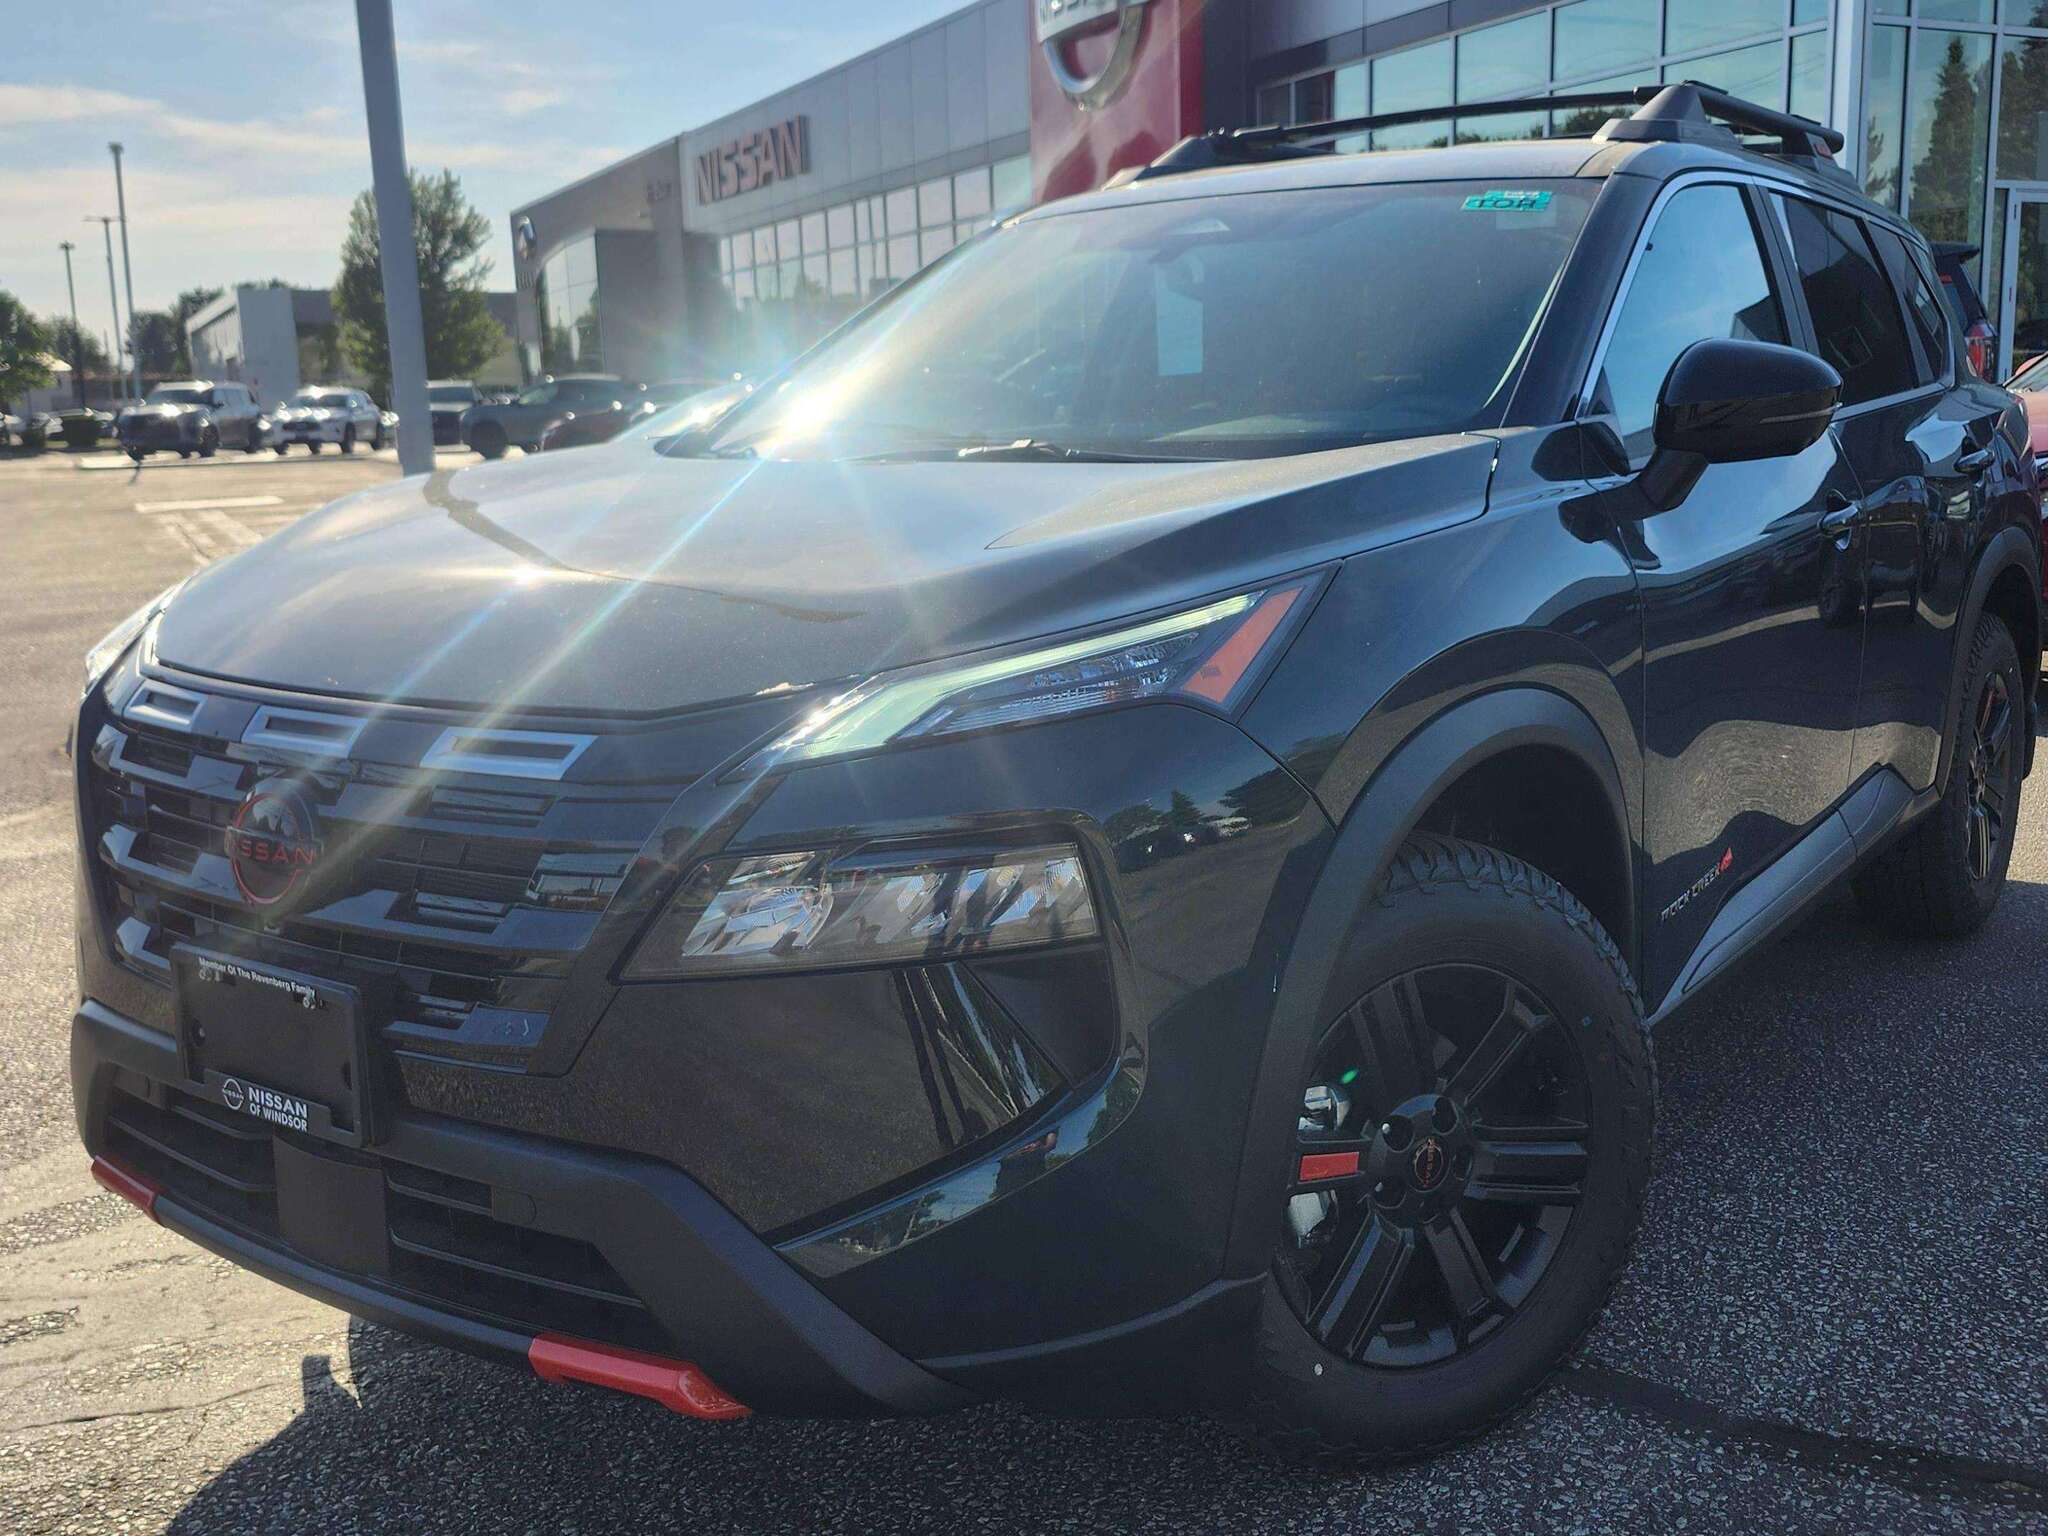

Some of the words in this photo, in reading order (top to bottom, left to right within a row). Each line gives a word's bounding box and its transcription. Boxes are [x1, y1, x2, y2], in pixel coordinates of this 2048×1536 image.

[696, 114, 811, 206] NISSAN
[248, 1086, 308, 1118] NISSAN
[249, 1102, 260, 1117] OF
[262, 1106, 308, 1132] WINDSOR
